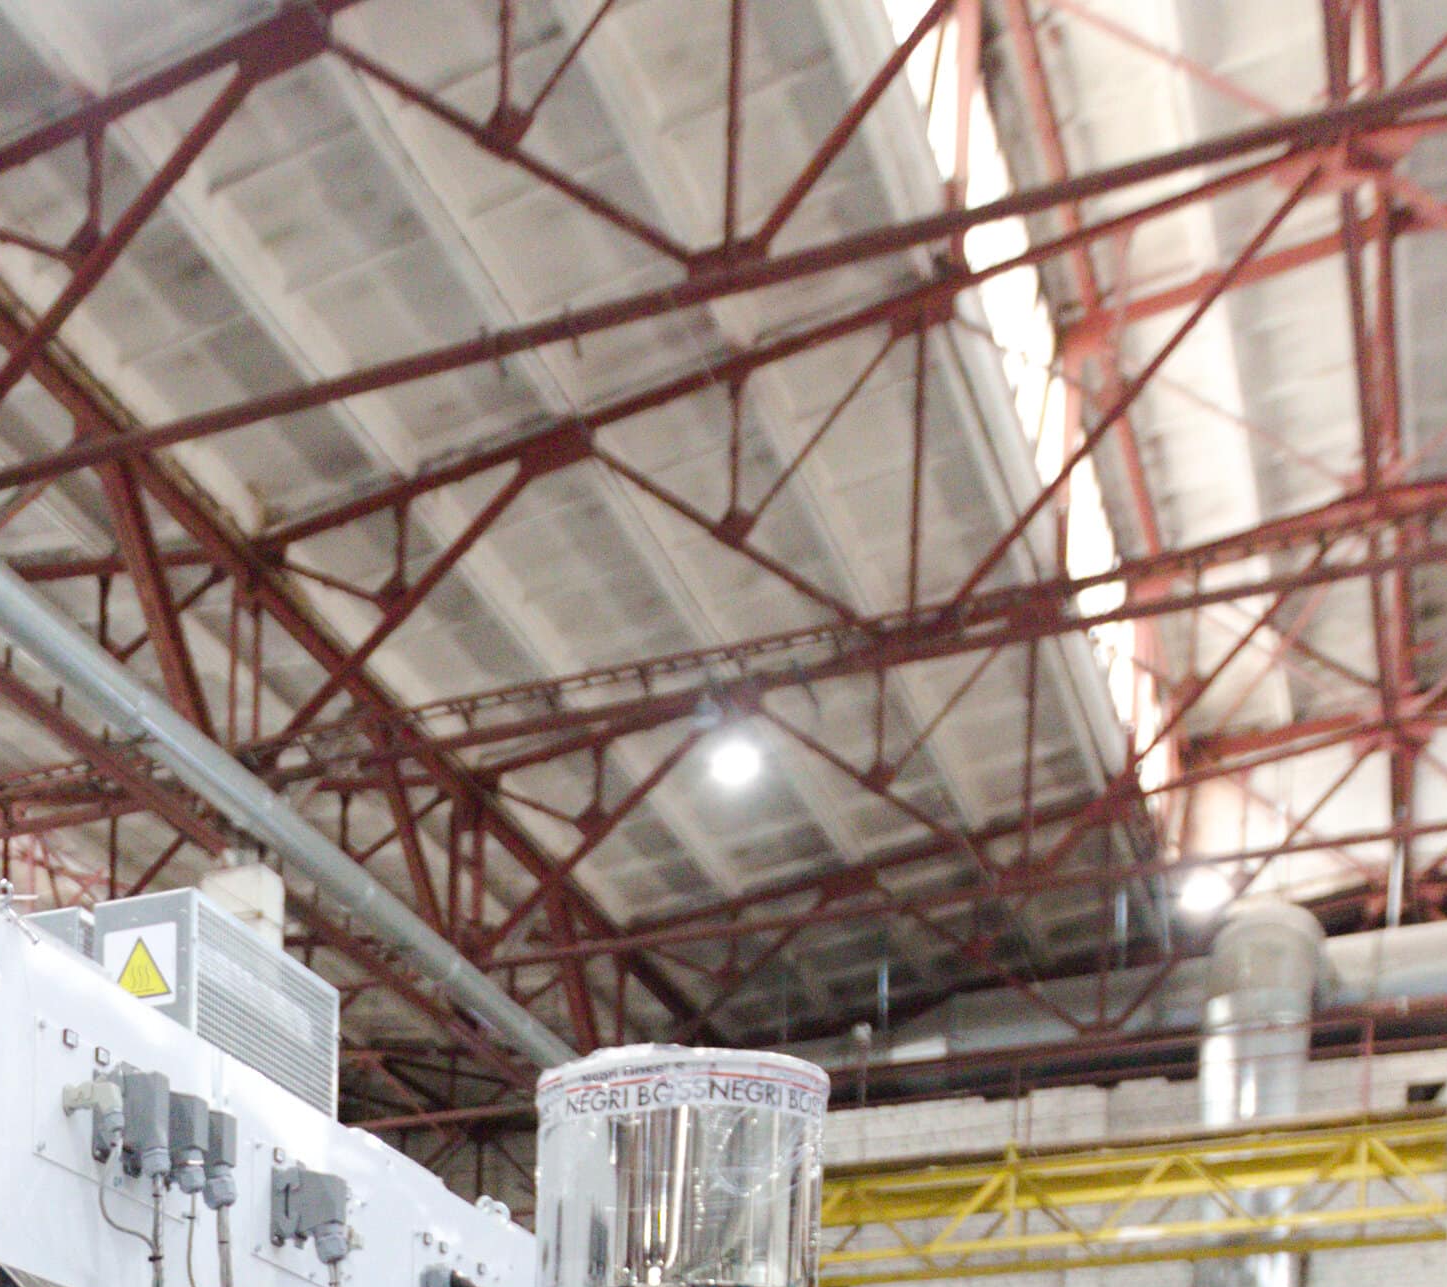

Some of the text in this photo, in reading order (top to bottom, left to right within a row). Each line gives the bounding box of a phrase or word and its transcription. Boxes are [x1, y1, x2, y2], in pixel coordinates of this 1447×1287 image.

[565, 1078, 707, 1116] NEGRI BOSS
[708, 1078, 783, 1107] NEGRI
